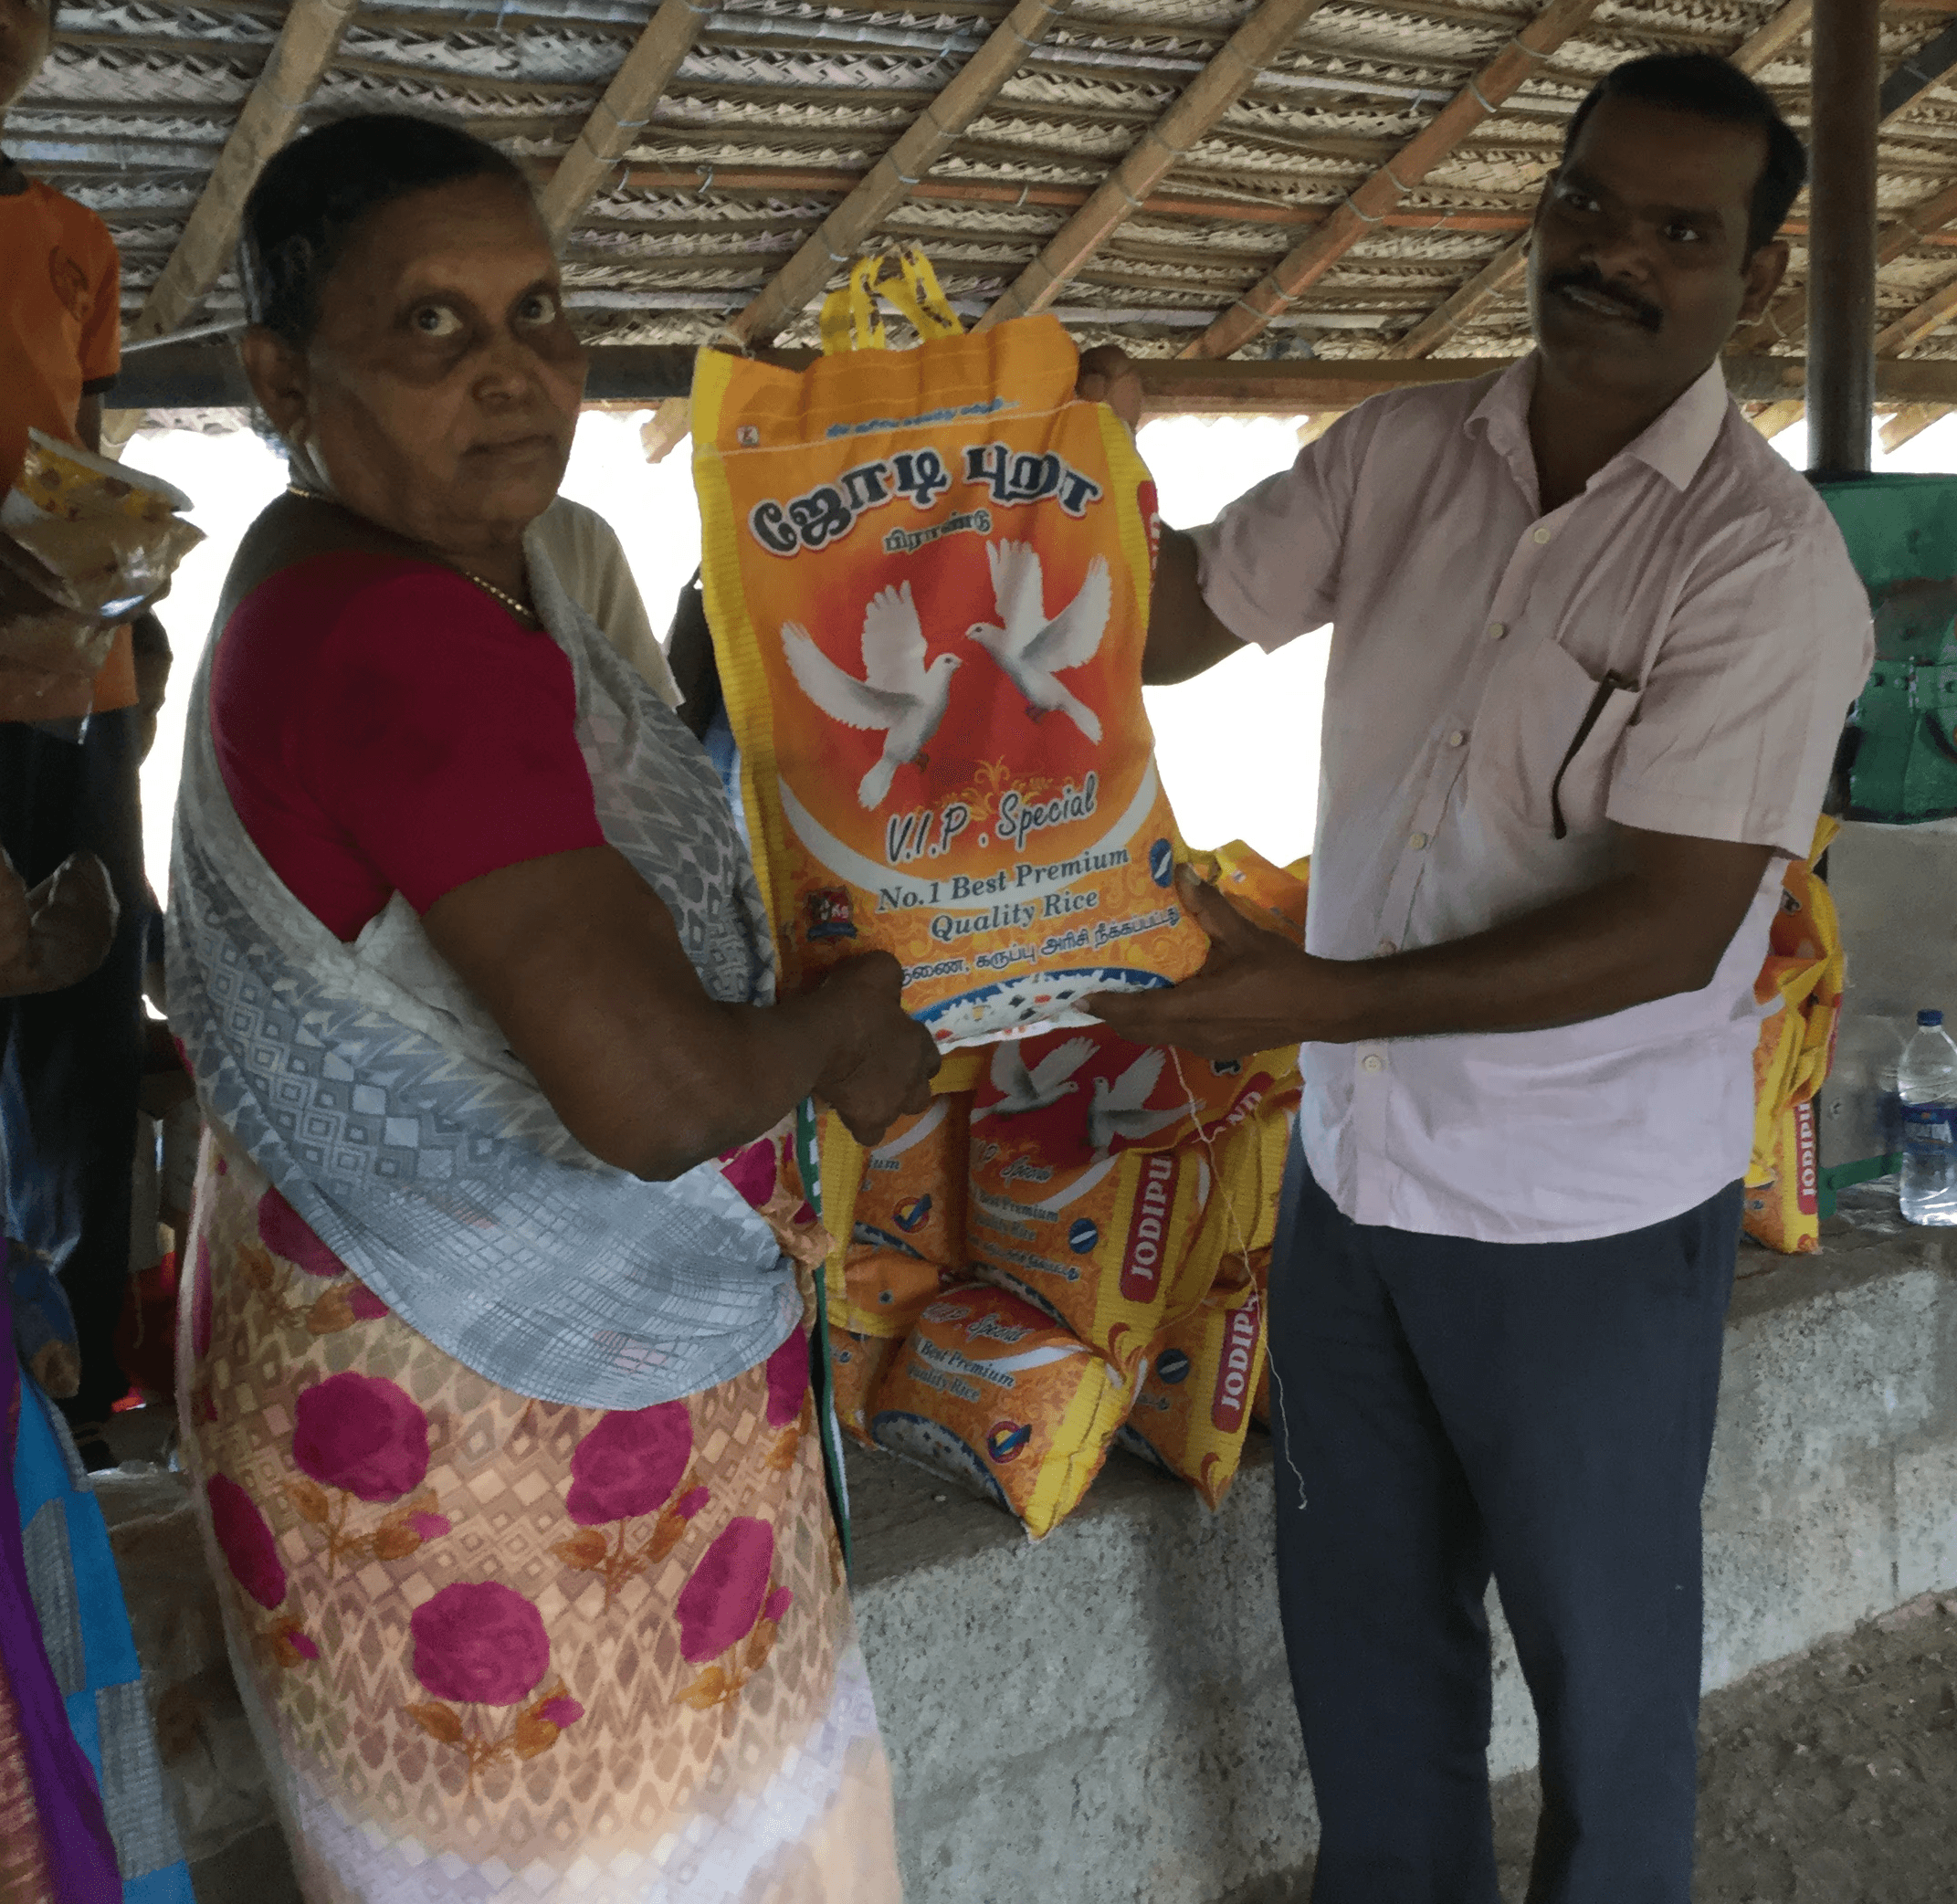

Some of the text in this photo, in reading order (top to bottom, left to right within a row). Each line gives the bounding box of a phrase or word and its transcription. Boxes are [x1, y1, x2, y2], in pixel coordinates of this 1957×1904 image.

[750, 442, 1102, 555] ஜோடி புறா
[996, 772, 1097, 851] Special
[878, 881, 939, 911] No.1
[952, 871, 1006, 899] Best
[1015, 848, 1129, 888] Premium
[931, 889, 1098, 941] Quality Rice
[975, 942, 1036, 969] கருப்பு
[1042, 928, 1089, 955] அரிசி
[948, 1350, 1015, 1388] Premium
